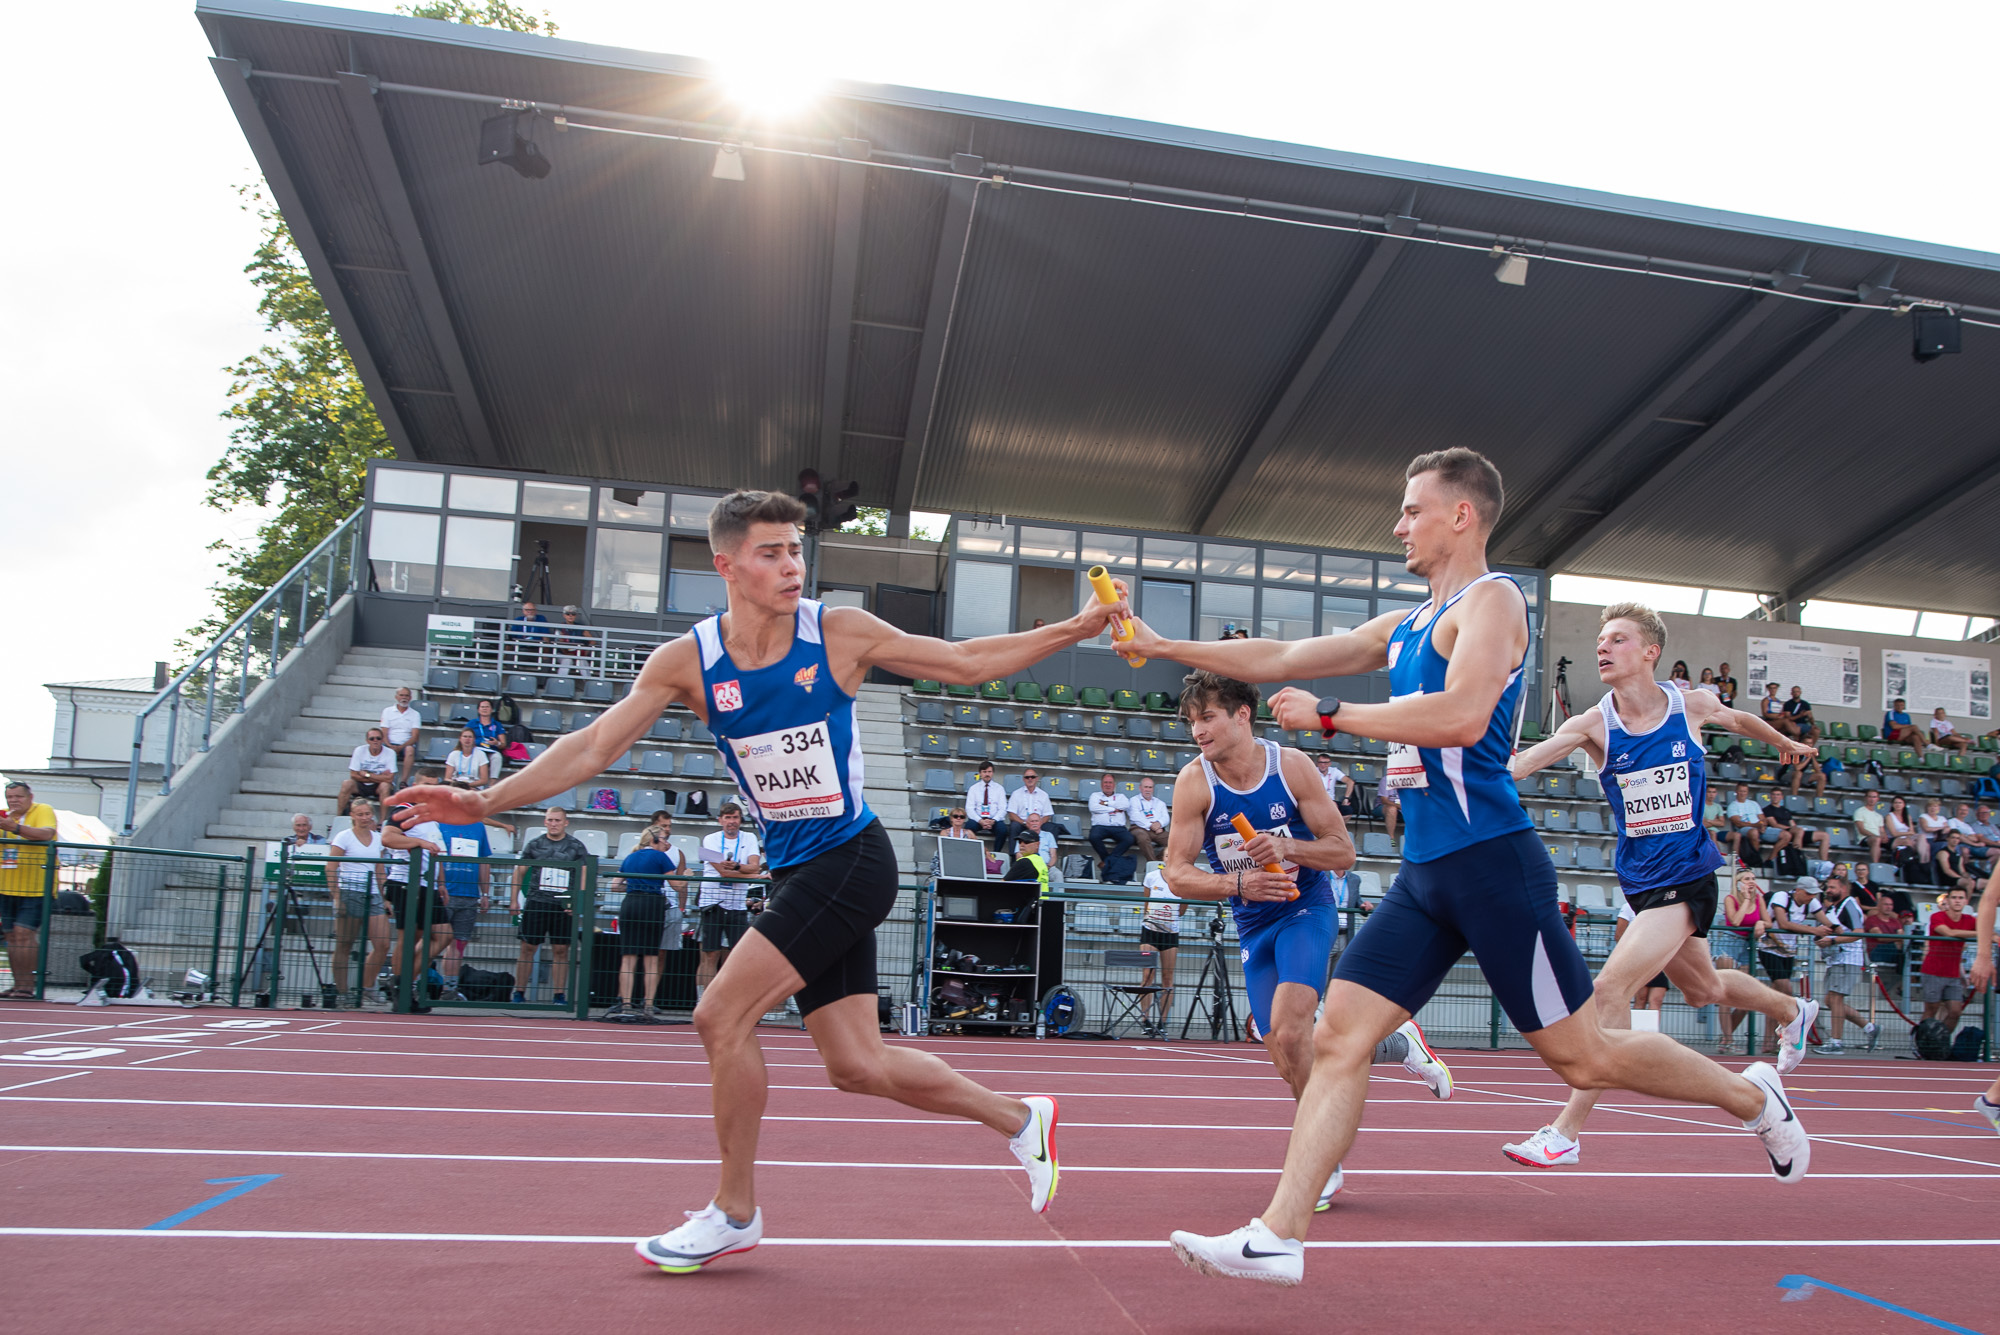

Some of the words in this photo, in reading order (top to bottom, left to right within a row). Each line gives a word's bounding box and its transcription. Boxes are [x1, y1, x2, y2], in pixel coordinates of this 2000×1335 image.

[781, 728, 825, 754] 334
[754, 764, 822, 792] PAJĄK
[1653, 765, 1687, 784] 373
[769, 807, 809, 820] SUWAŁKI
[810, 806, 830, 816] 2021
[1625, 790, 1692, 815] RZYBYLAK
[1634, 825, 1669, 835] SUWAŁKI
[1669, 822, 1689, 831] 2021
